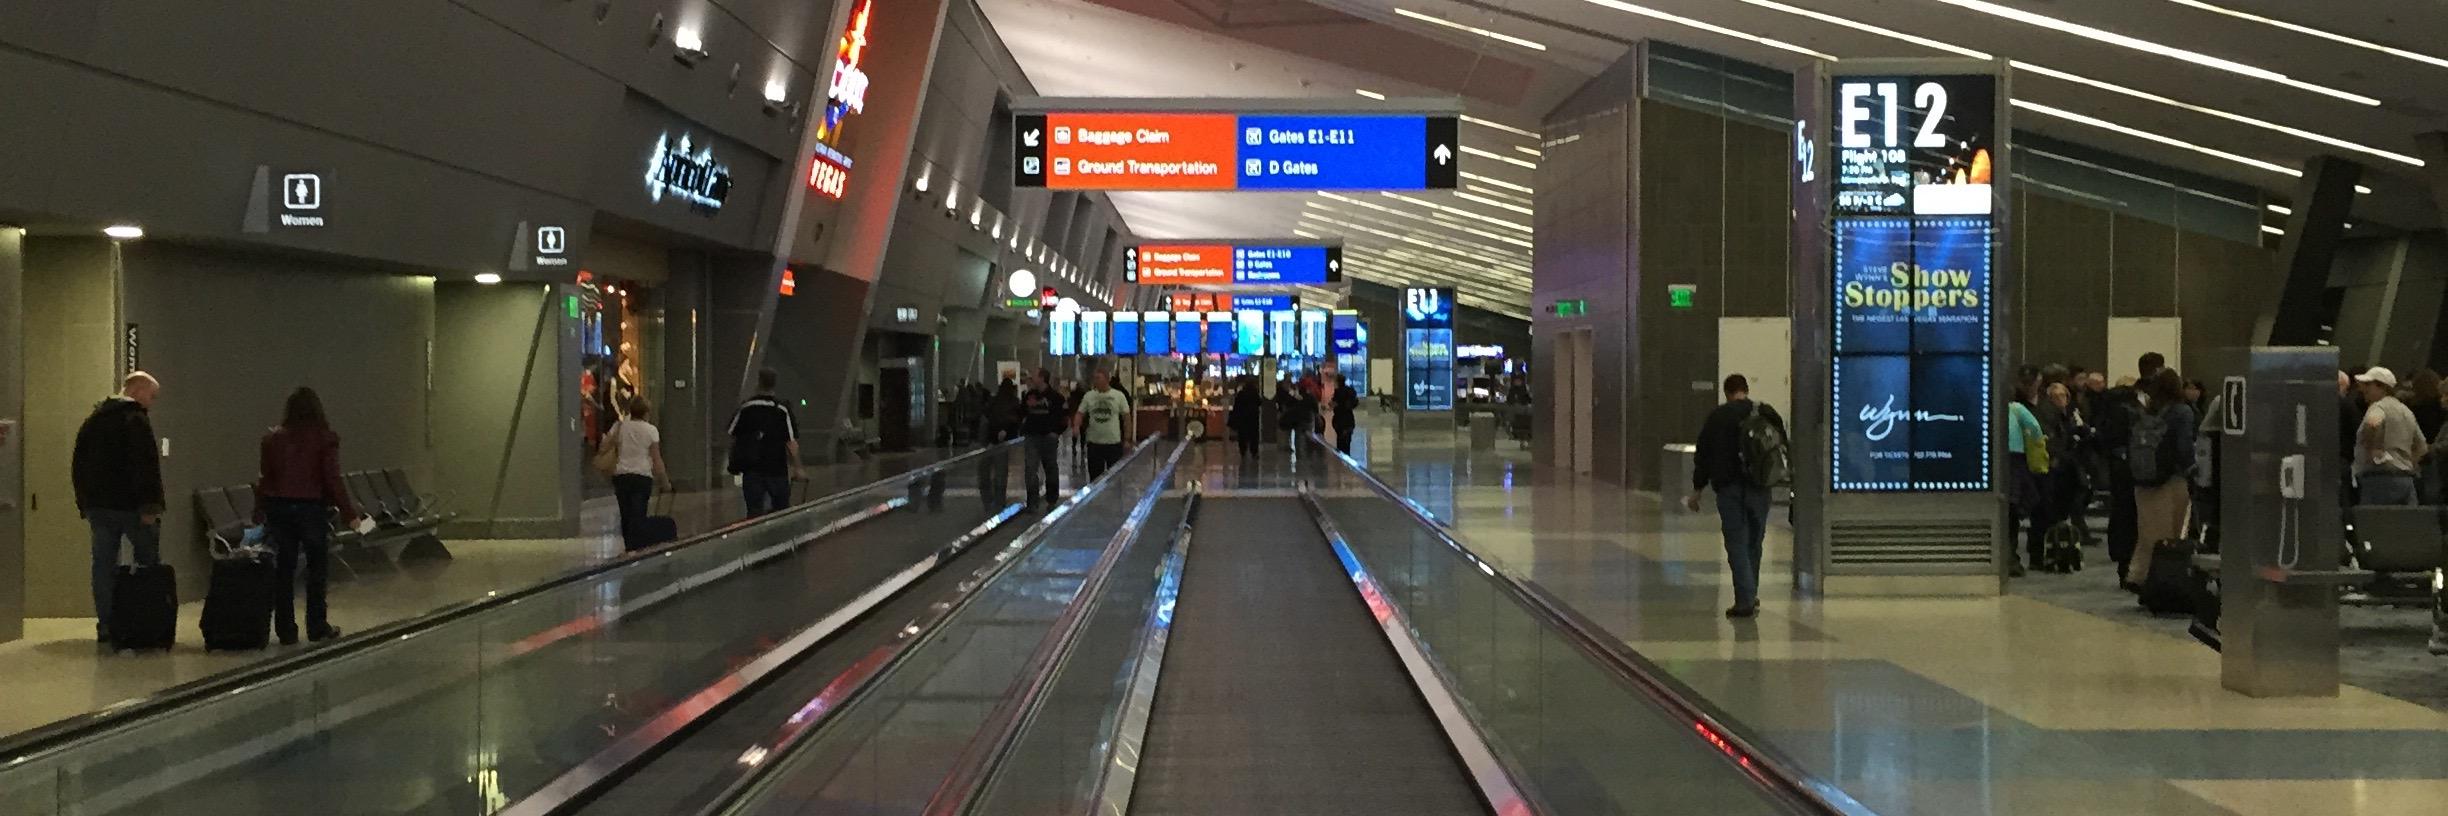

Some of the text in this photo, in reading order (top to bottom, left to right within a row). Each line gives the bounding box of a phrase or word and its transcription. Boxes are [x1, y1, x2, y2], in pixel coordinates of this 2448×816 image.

[1841, 82, 1947, 147] E12
[1078, 128, 1169, 145] Baggage Claim
[1269, 129, 1354, 144] Gates E1-E11
[1842, 149, 1877, 165] Flight
[1078, 159, 1217, 176] Ground Transportation
[1269, 160, 1318, 175] D Gates
[810, 158, 847, 199] VEGAS
[281, 213, 323, 226] Women
[536, 256, 567, 265] Women
[1154, 252, 1181, 262] Baggage
[1248, 250, 1265, 258] Gates
[1178, 267, 1224, 277] Transportation
[1891, 262, 1971, 287] Show
[1844, 281, 1978, 311] Stoppers
[128, 328, 137, 373] Wom
